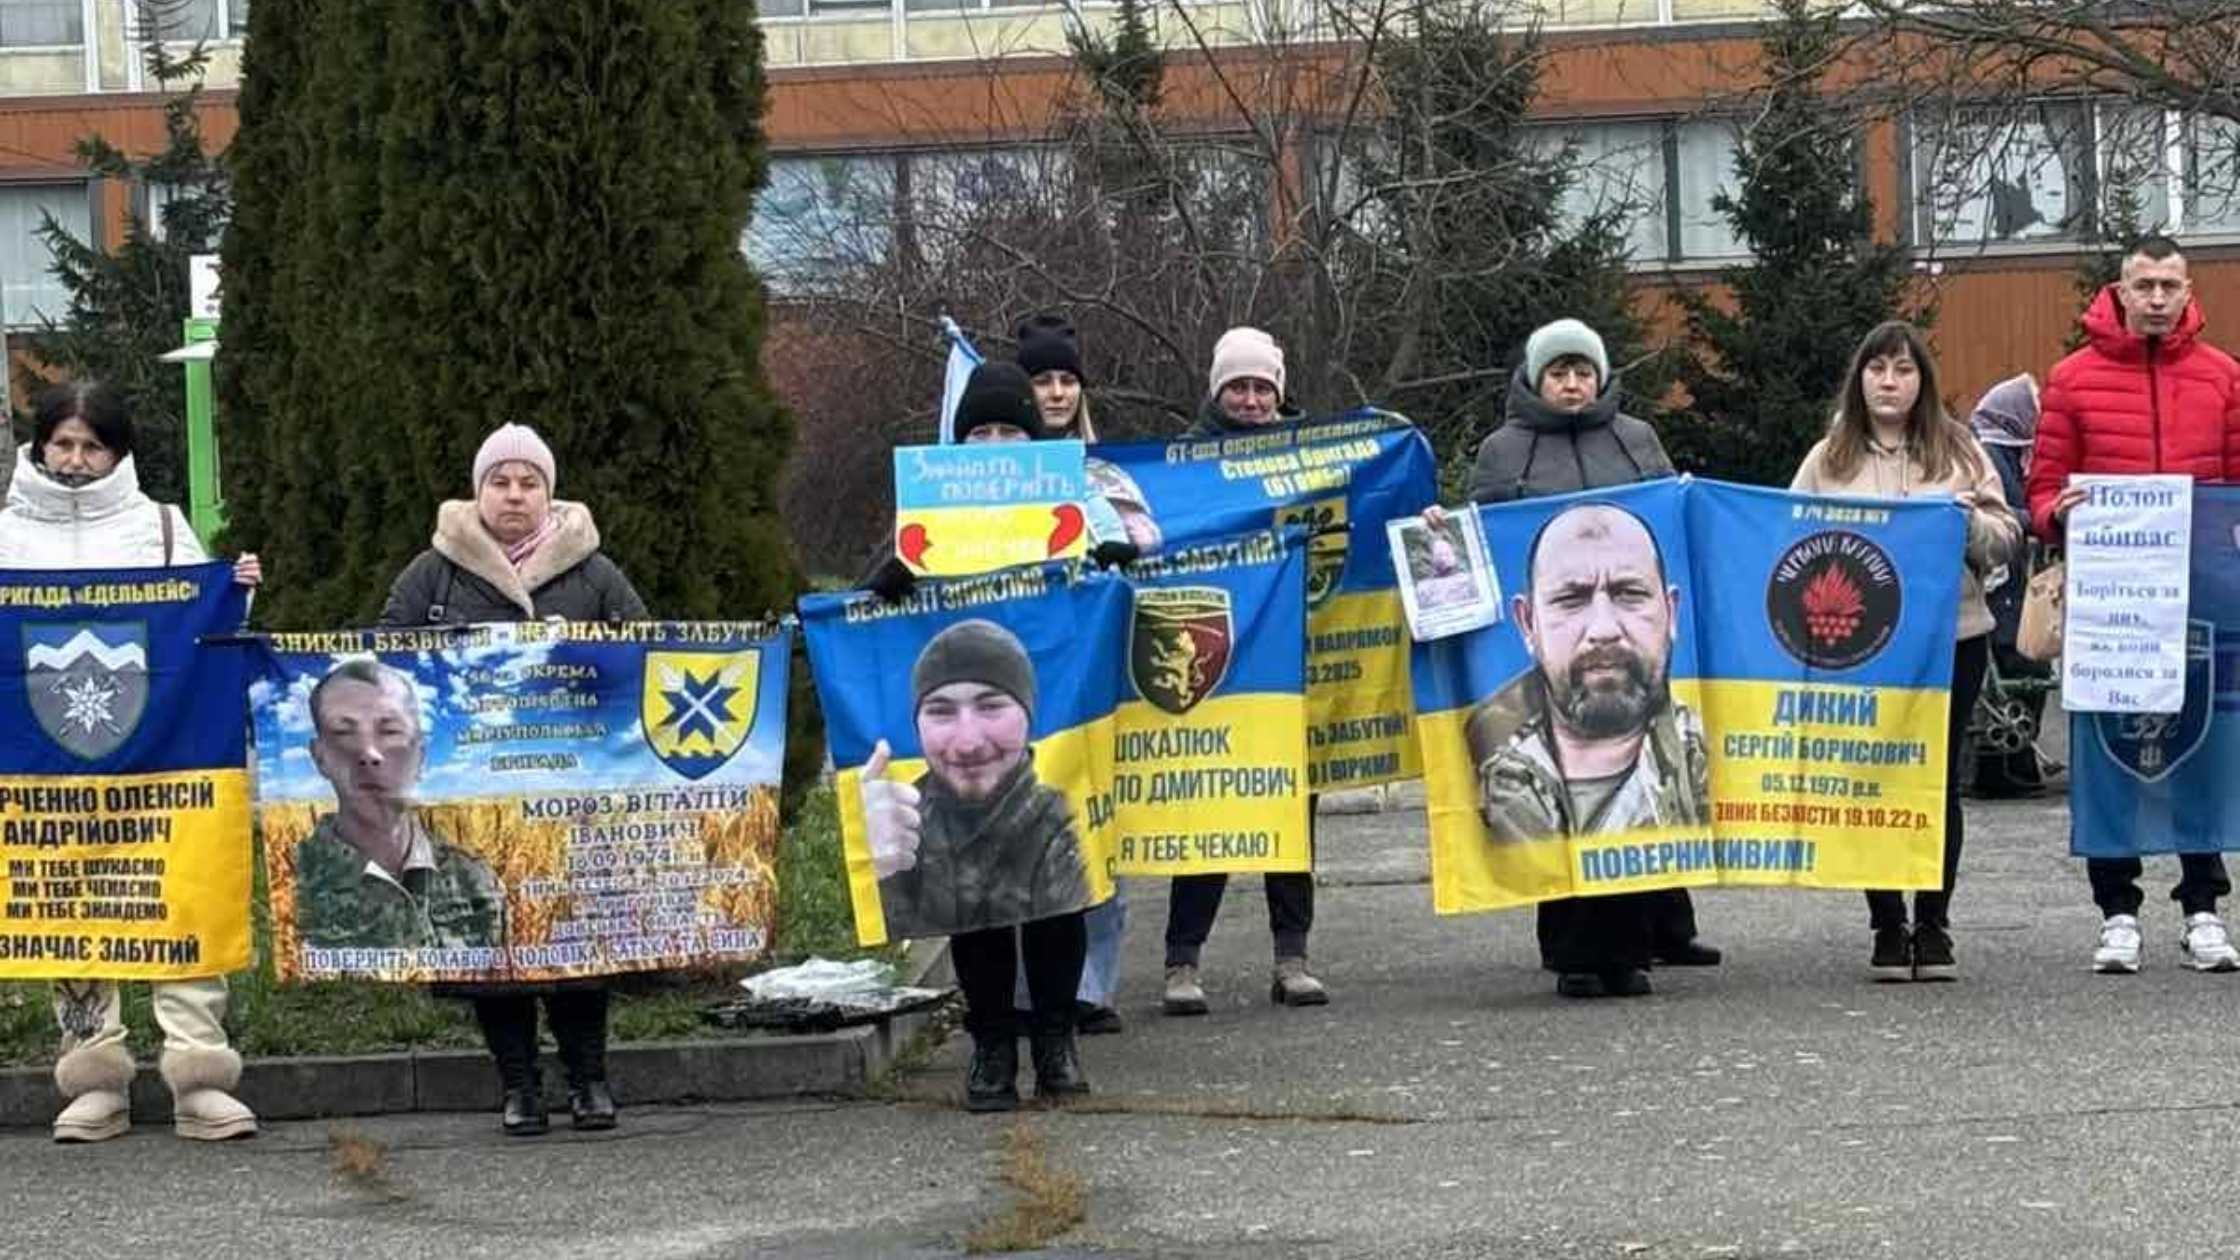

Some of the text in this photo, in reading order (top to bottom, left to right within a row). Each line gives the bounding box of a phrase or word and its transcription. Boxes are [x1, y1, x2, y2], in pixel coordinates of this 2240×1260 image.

[2089, 485, 2174, 507] Полон
[270, 632, 363, 652] ЗНИКЛІ
[521, 663, 598, 681] ОКРЕМА
[1773, 687, 1878, 727] ДИКИЙ
[1724, 731, 1794, 759] СЕРГІЙ
[0, 776, 214, 814] РЧЕНКО ОЛЕКСІЙ
[1146, 766, 1297, 806] ДМИТРОВИЧ
[521, 784, 748, 819] МОРОЗ ВІТАЛІЙ
[1845, 806, 1911, 828] 19.10.22
[4, 815, 171, 849] АНДРІЙОВИЧ
[569, 820, 697, 845] ІВАНОВИЧ
[1121, 837, 1136, 862] Я
[1141, 834, 1189, 862] ТЕБЕ
[1194, 831, 1268, 860] ЧЕКАЮ
[9, 856, 165, 877] МИ ТЕБЕ ШУКАЄМО
[13, 880, 161, 898] МИ ТЕБЕ ЧЕКАЄМО
[7, 902, 168, 923] МИ ТЕБЕ ЗНАЙДЕМО
[0, 934, 200, 964] ЗНАЧАЄ ЗАБУТИЙ
